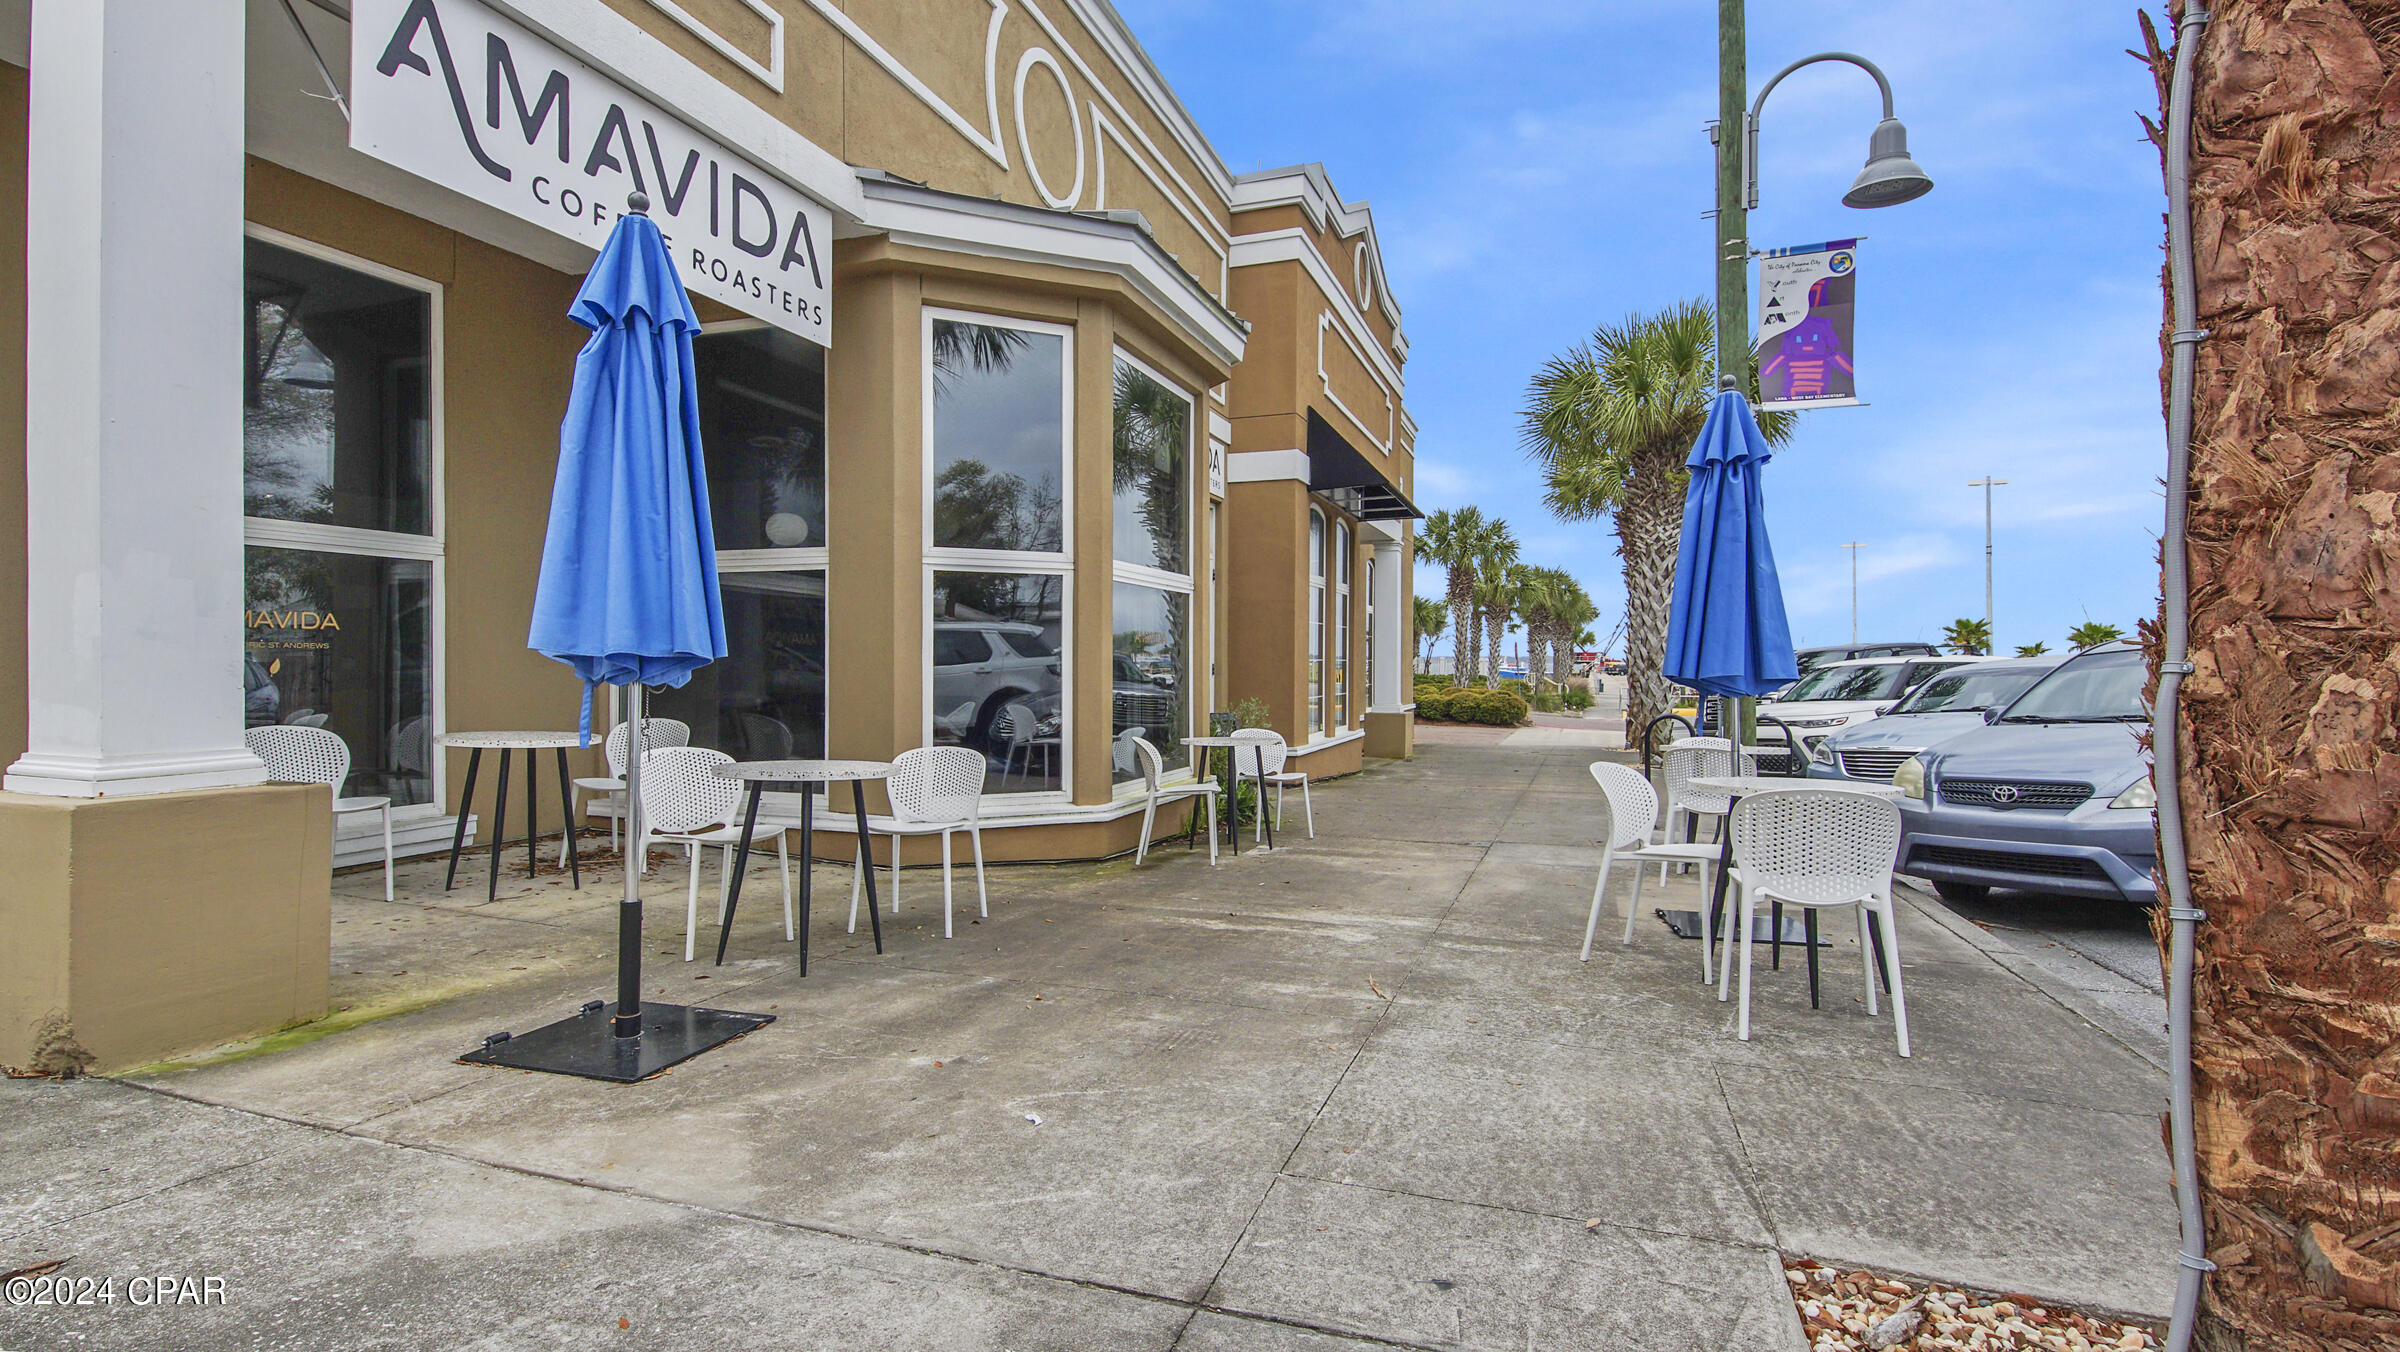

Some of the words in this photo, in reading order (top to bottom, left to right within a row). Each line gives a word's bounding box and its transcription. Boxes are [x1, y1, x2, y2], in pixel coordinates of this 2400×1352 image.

[376, 0, 824, 290] AMAVIDA
[532, 176, 673, 249] COF
[693, 248, 823, 327] ROASTERS
[1775, 263, 1785, 271] City
